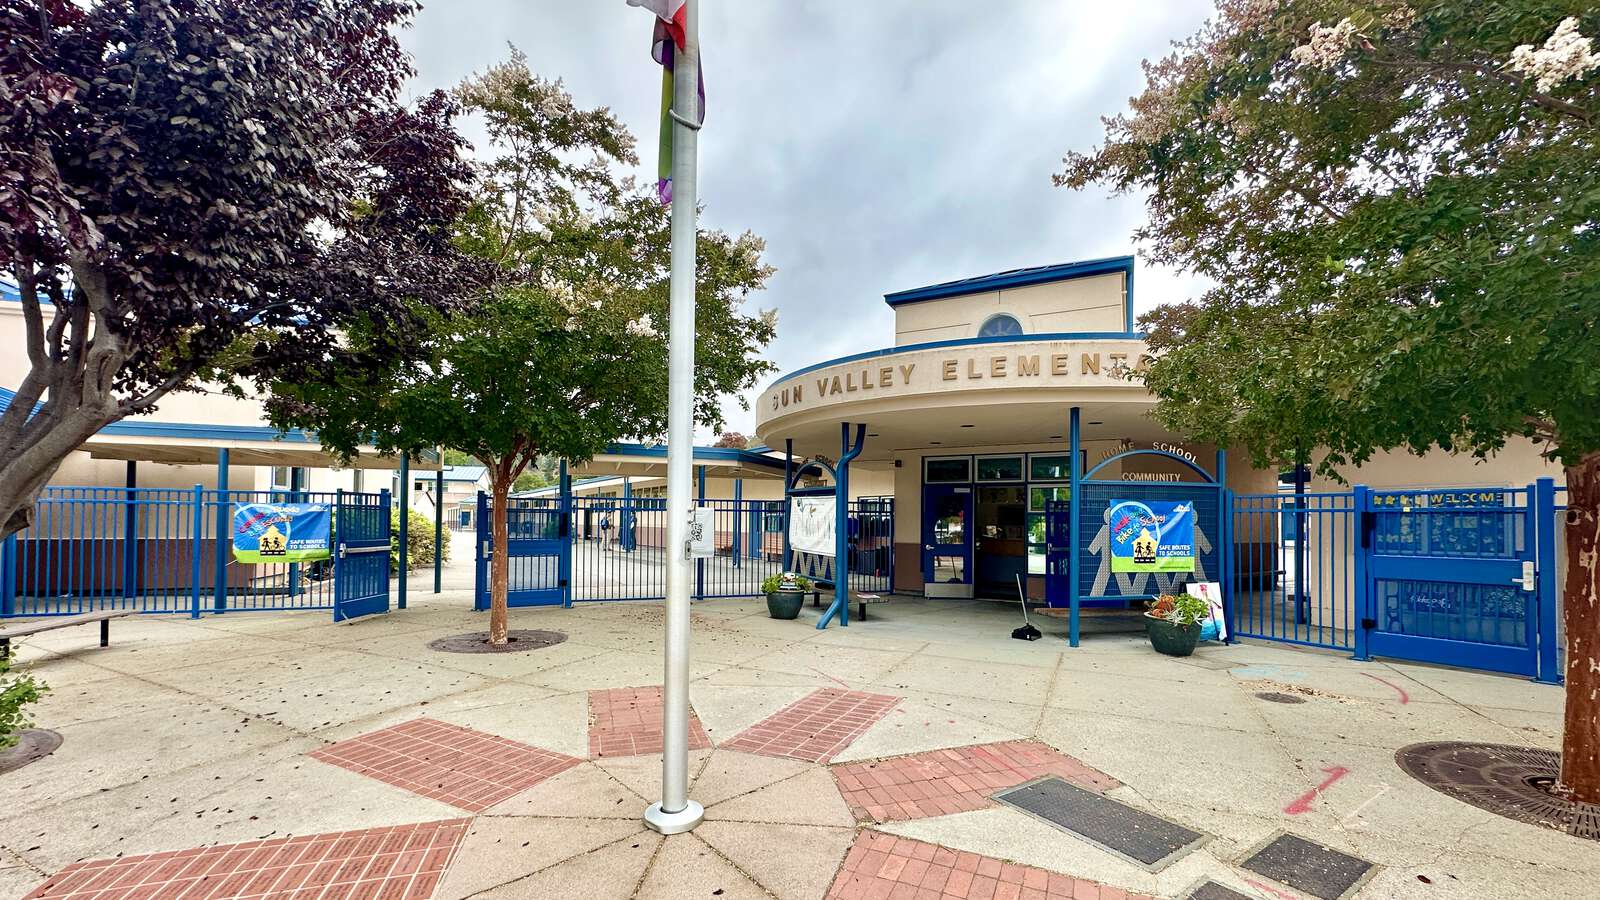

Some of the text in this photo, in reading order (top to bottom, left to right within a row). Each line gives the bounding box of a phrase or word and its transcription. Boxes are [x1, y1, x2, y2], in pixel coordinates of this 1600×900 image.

[772, 384, 803, 411] SUN
[816, 363, 916, 397] VALLEY
[1102, 441, 1198, 465] HOME SCHOOL
[1121, 472, 1181, 482] COMMUNITY
